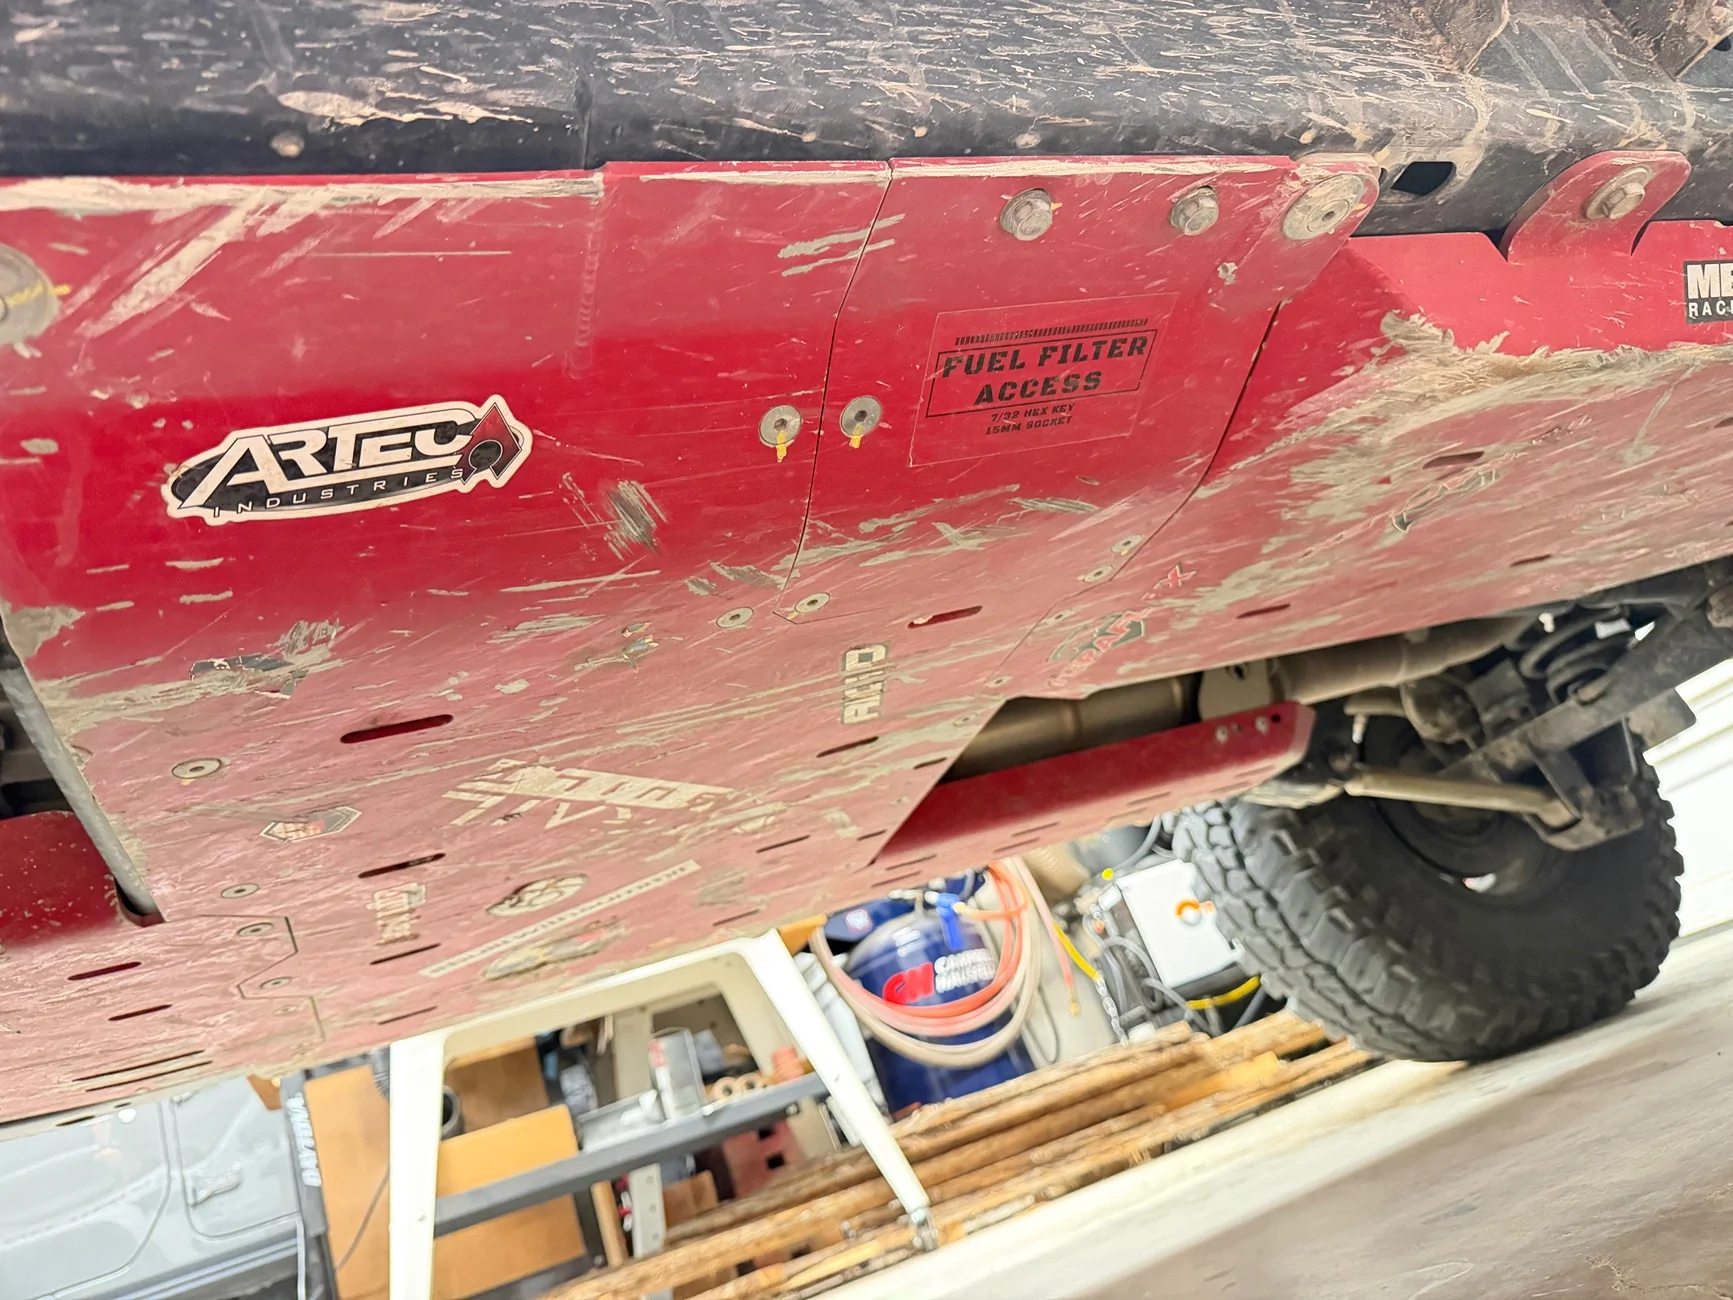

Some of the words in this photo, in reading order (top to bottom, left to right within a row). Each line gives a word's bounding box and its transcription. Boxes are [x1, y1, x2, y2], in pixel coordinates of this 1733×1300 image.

[943, 349, 1026, 378] FUEL
[1038, 335, 1148, 367] FILTER
[974, 371, 1102, 405] ACCESS
[986, 422, 1021, 435] 15MM
[1026, 416, 1073, 430] SOCKET
[991, 410, 1020, 422] 7/32
[1024, 407, 1048, 417] HEX
[1052, 403, 1076, 414] KEY
[178, 408, 475, 510] ARTEC
[213, 467, 465, 518] INDUSTRIES
